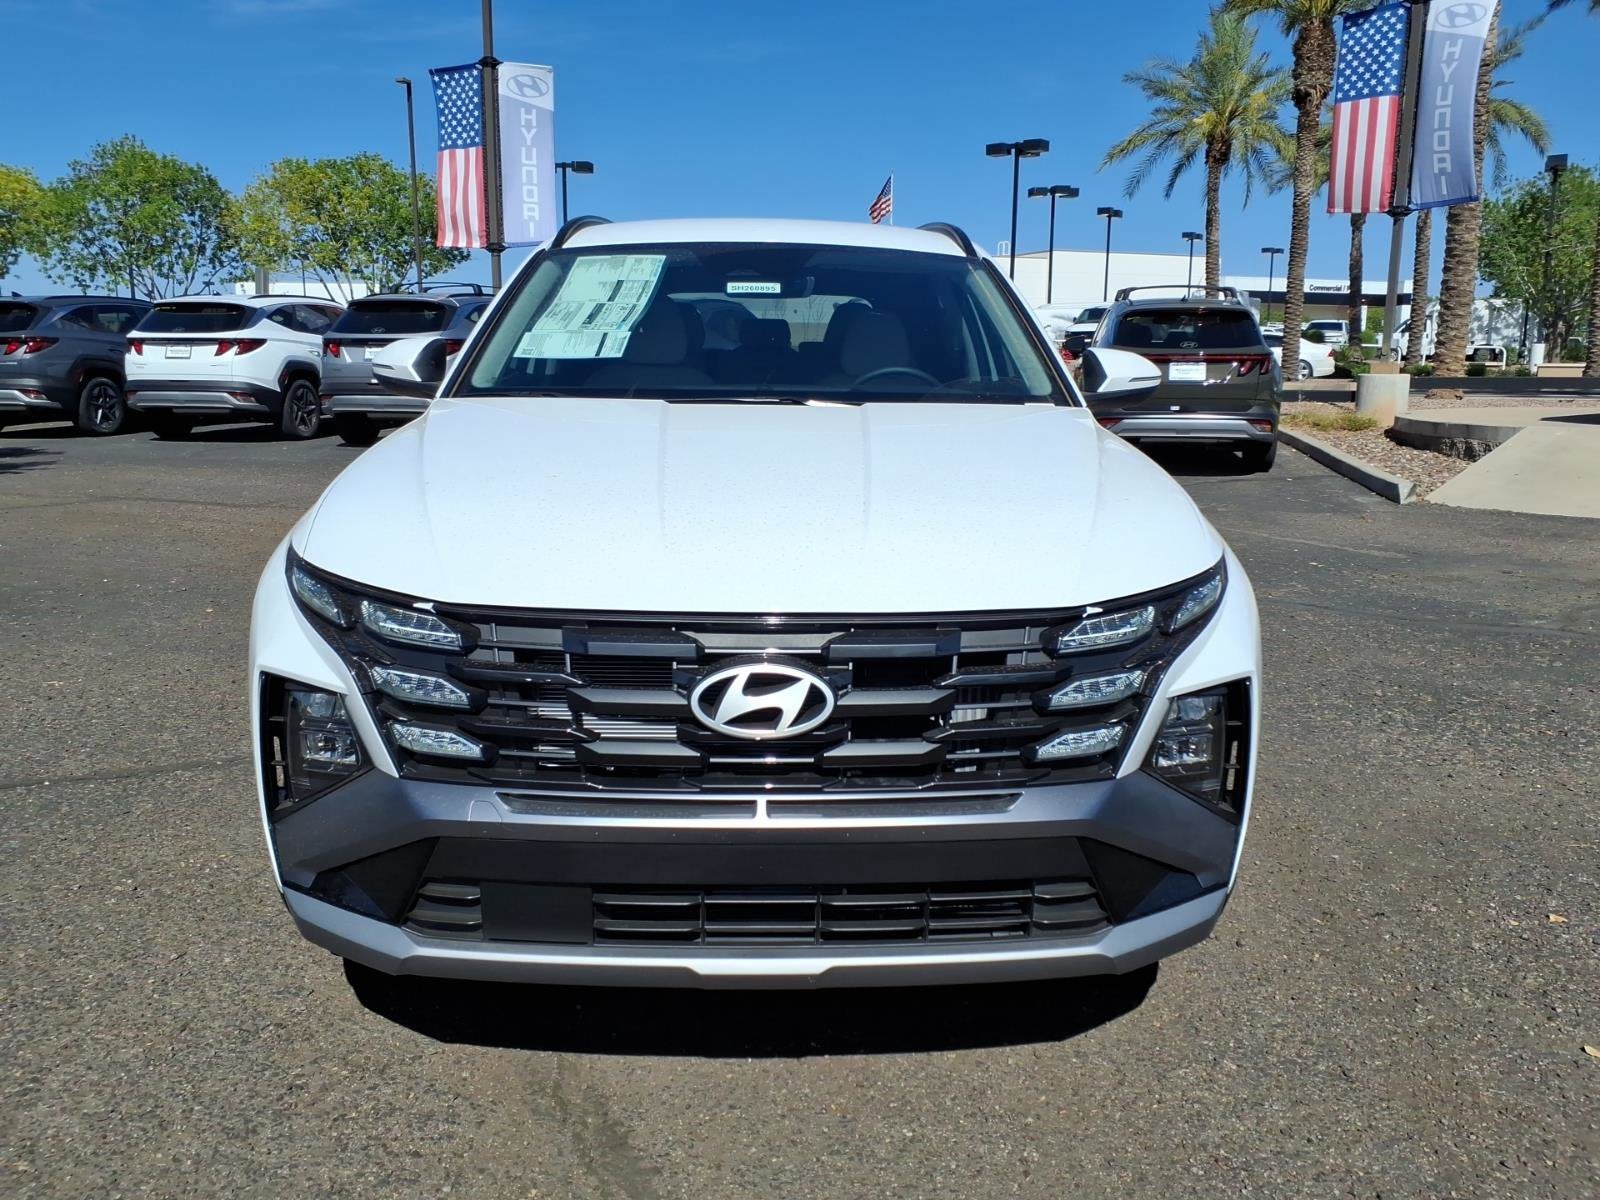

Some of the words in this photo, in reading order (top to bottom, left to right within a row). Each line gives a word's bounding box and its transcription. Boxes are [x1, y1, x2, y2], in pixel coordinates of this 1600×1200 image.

[520, 107, 540, 238] HYUNDAI
[1433, 38, 1463, 195] HYUNDAI
[1309, 284, 1342, 292] Commercial
